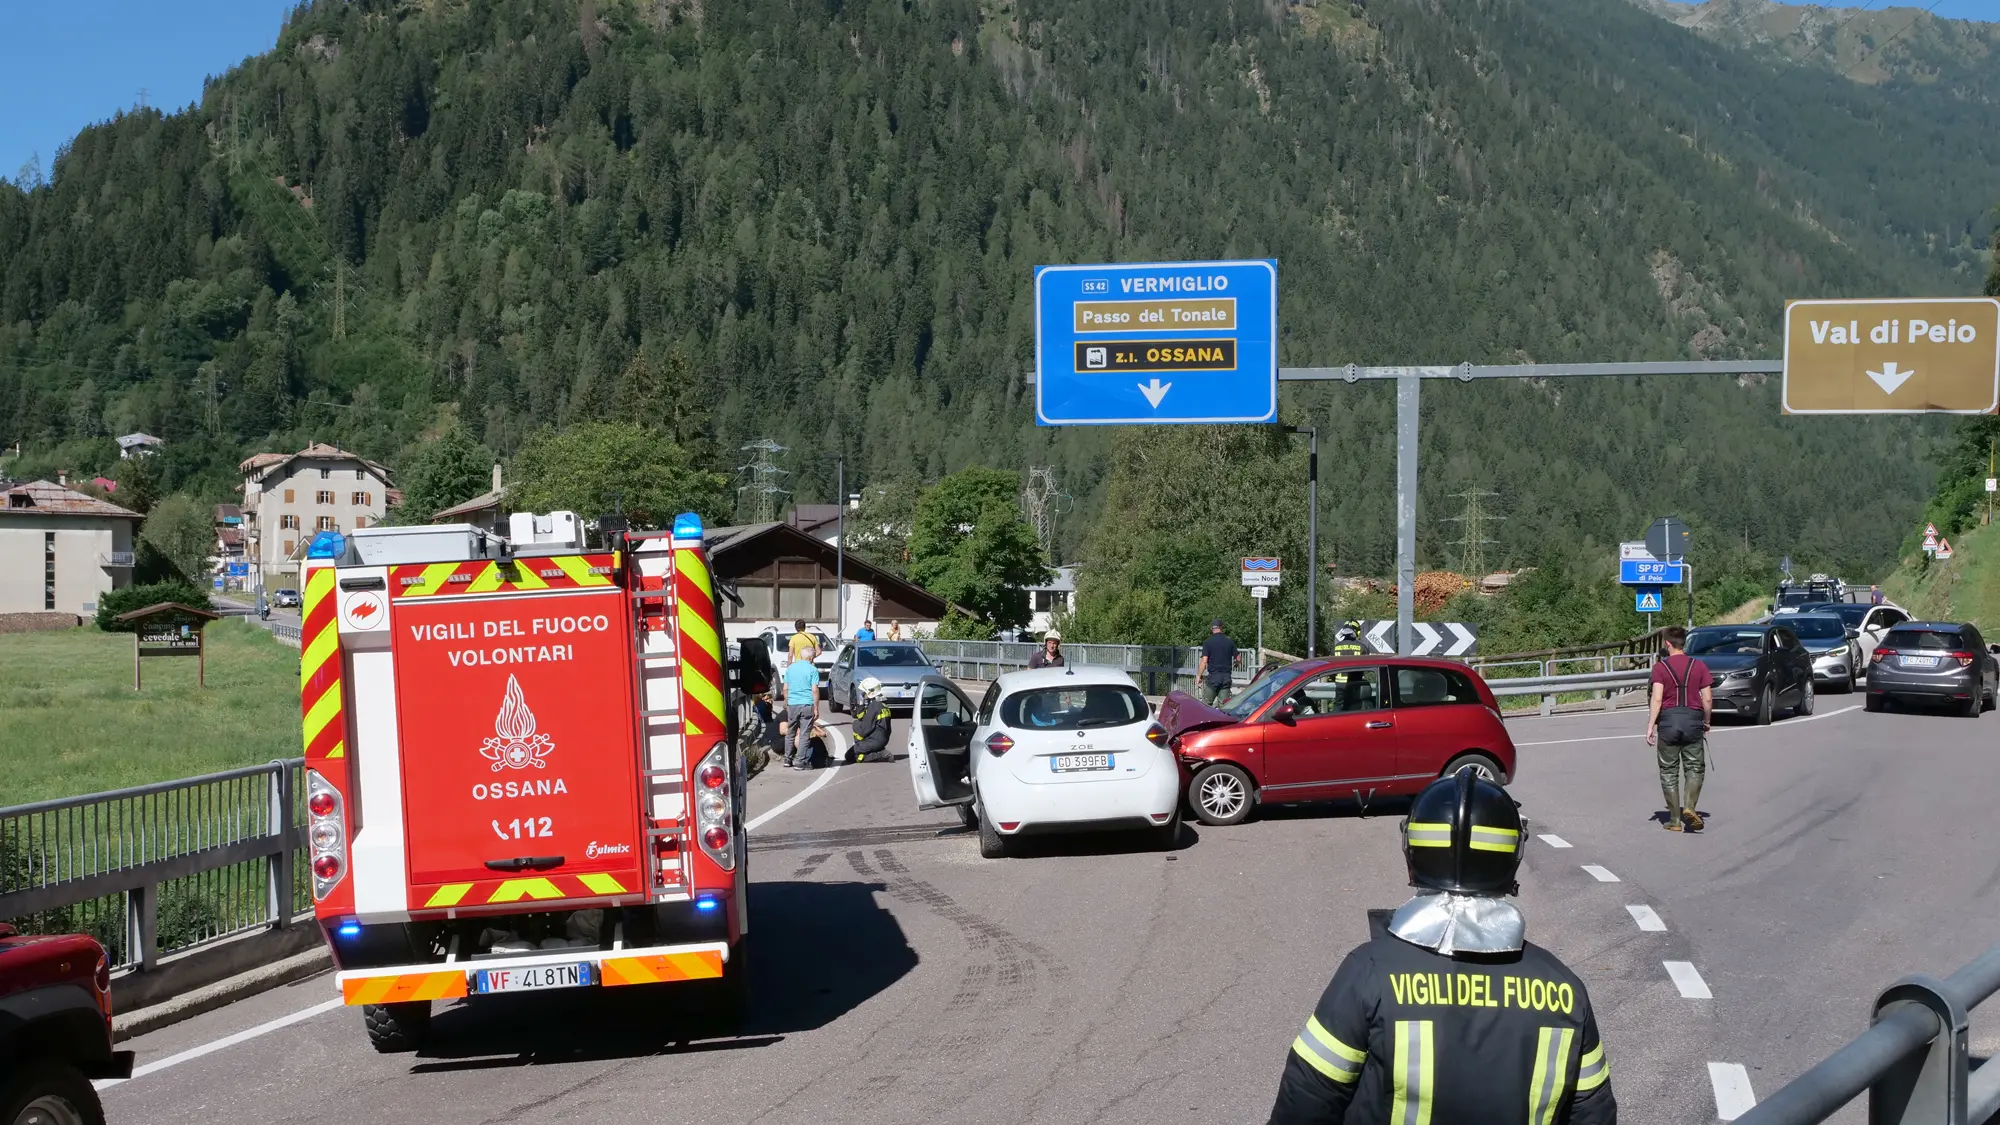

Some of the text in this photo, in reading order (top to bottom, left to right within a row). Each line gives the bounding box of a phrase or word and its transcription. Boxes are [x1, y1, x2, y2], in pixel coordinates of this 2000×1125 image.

[1085, 275, 1228, 293] SS 42 VERMIGLIO
[1082, 308, 1227, 324] Passo del Tonale
[1810, 318, 1977, 345] Val di Peio
[1147, 347, 1225, 363] OSSANA
[1652, 564, 1664, 572] 87
[411, 615, 609, 641] VIGILI DEL FUOCO
[448, 644, 573, 667] VOLONTARI
[1058, 755, 1107, 768] GD 399FB
[472, 778, 568, 800] OSSANA
[509, 816, 554, 839] 112
[585, 841, 630, 859] Fulmix
[489, 971, 511, 990] VF
[522, 966, 579, 987] 4L8TN
[1390, 972, 1574, 1015] VIGILI DEL FUOCO
